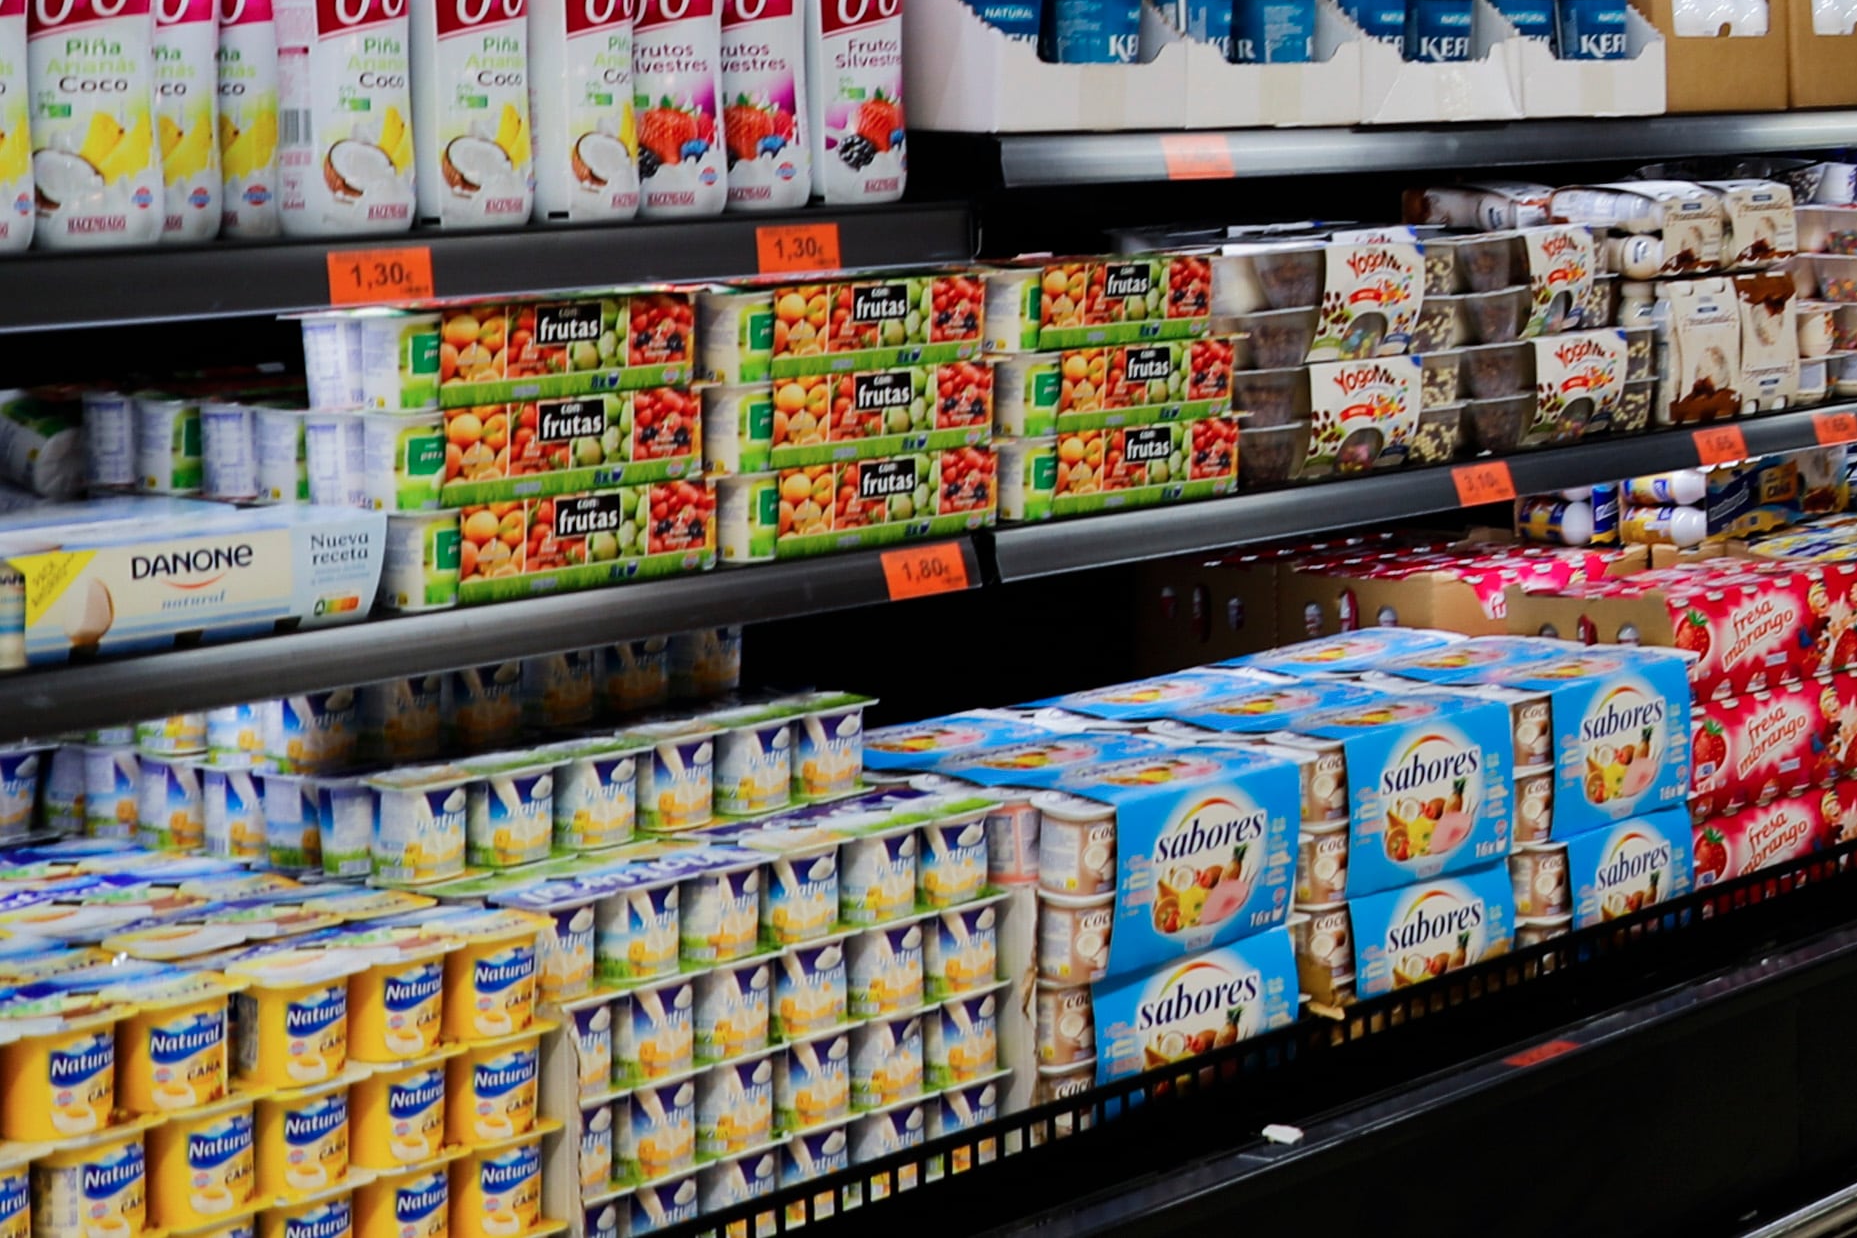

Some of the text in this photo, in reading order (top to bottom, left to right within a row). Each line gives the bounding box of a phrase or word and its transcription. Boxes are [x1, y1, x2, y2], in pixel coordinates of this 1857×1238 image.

[66, 38, 122, 55] Piña
[721, 41, 770, 58] rutos
[1420, 36, 1471, 62] KEF
[1580, 33, 1626, 59] KEF
[632, 58, 709, 75] ilvestres
[722, 59, 787, 75] vestres
[59, 75, 129, 94] Coco
[160, 79, 188, 96] co
[774, 237, 825, 261] 1,30€
[350, 261, 414, 289] 1,30€
[1106, 273, 1150, 297] frutas
[855, 296, 907, 321] frutas
[539, 315, 599, 342] frutas
[1127, 357, 1170, 380] frutas
[858, 381, 911, 409] frutas
[542, 411, 603, 438] frutas
[1126, 439, 1171, 462] frutas
[862, 469, 914, 497] frutas
[558, 506, 619, 534] frutas
[310, 530, 371, 552] Nueva
[311, 545, 370, 566] receta
[161, 588, 228, 611] natural
[1732, 598, 1773, 643] fresa
[1723, 609, 1794, 674] morango
[1581, 697, 1664, 744] sabores
[1747, 703, 1787, 747] fresa
[1738, 712, 1808, 782] morango
[1381, 745, 1480, 796] sabores
[1154, 810, 1265, 865] sabores
[1748, 809, 1789, 856] fresa
[1596, 842, 1671, 891] sabores
[1387, 900, 1483, 954] sabores
[1138, 972, 1258, 1032] sabores
